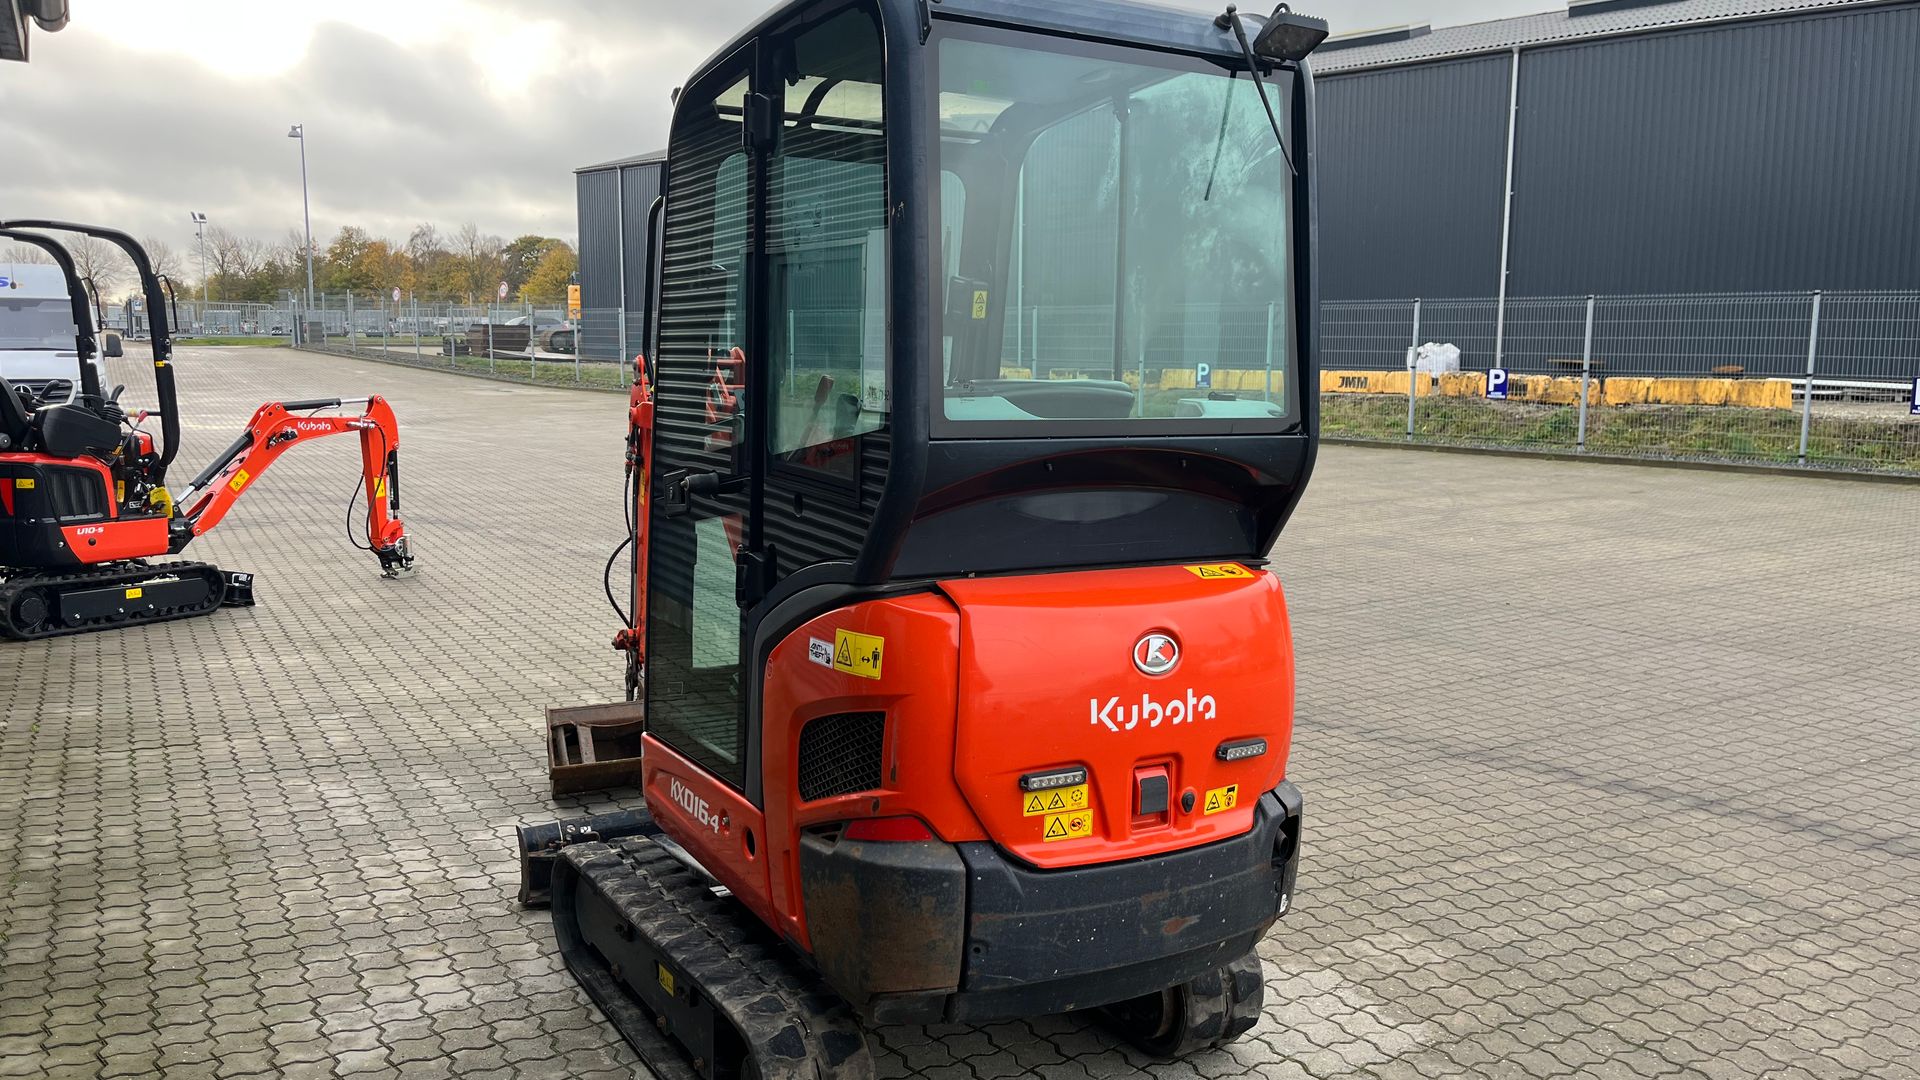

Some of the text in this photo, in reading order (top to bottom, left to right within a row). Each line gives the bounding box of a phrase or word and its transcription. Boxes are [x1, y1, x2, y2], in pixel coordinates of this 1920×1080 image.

[1337, 376, 1369, 389] JMM
[1488, 368, 1506, 392] P
[297, 421, 331, 431] Kubota
[1090, 688, 1216, 732] Kubota
[670, 777, 719, 834] KX016-4
